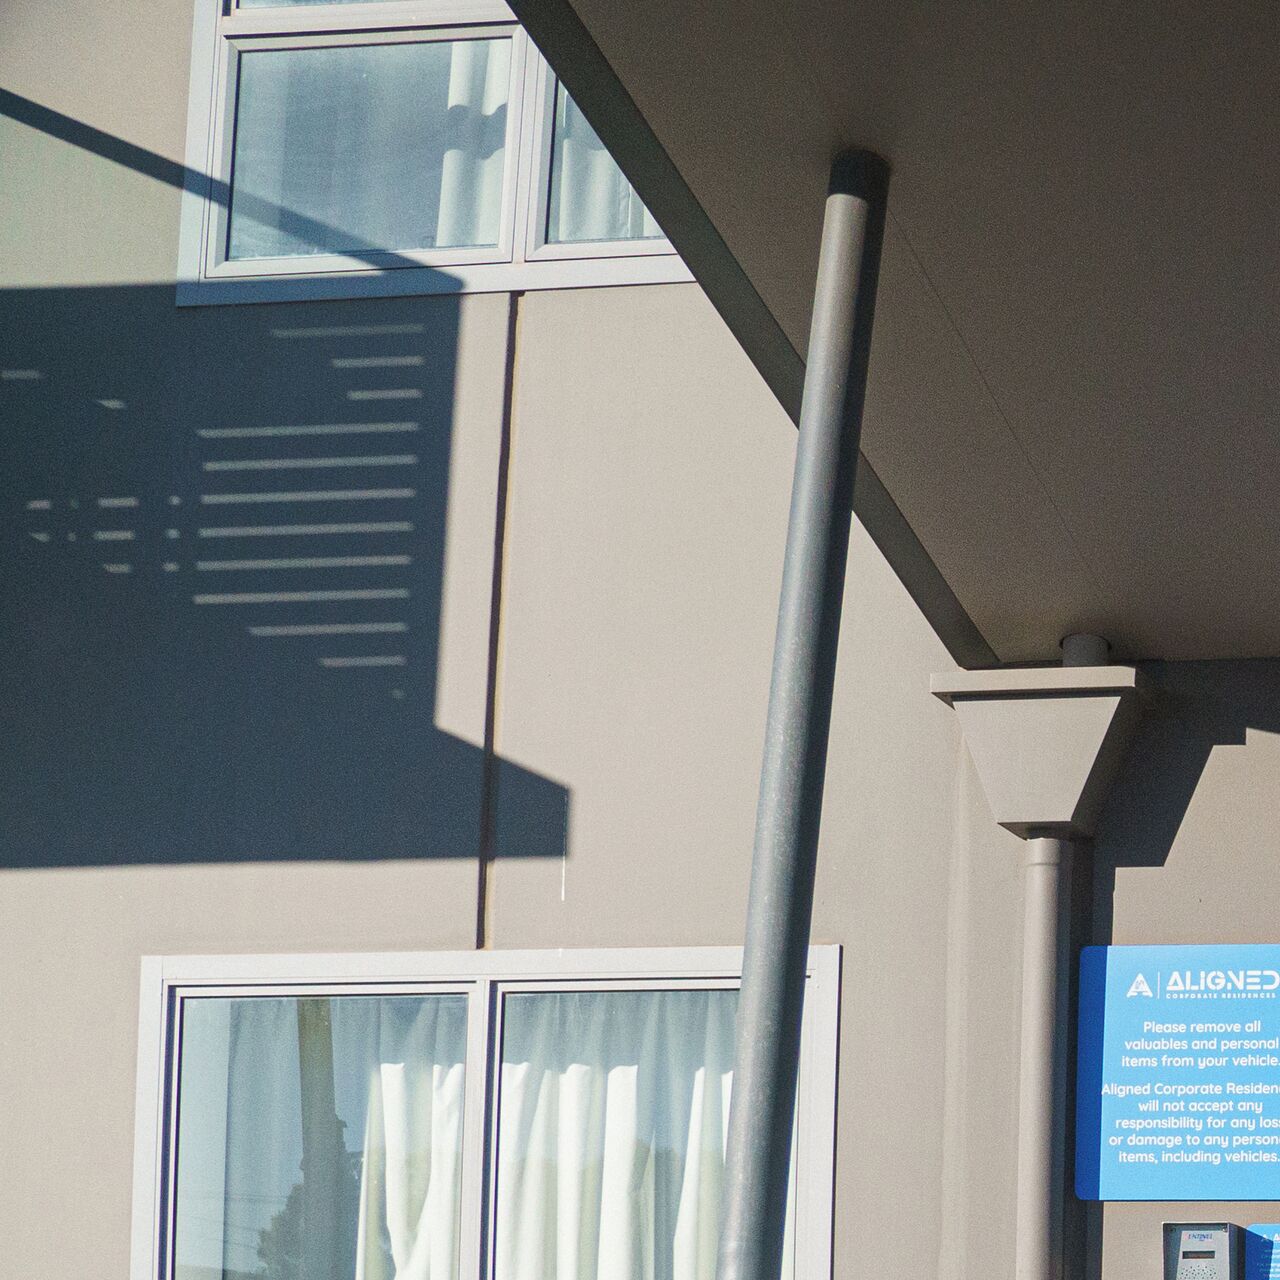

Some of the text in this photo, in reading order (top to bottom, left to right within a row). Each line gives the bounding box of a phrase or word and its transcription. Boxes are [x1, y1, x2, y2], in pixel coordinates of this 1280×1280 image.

[1166, 970, 1280, 990] ALIGNED
[1144, 1021, 1261, 1032] Please remove all
[1125, 1037, 1279, 1052] valuables and personal
[1122, 1055, 1280, 1069] items from your vehicle.
[1102, 1083, 1150, 1096] Aligned
[1155, 1083, 1222, 1096] Corporate
[1139, 1100, 1262, 1114] will not accept any
[1115, 1116, 1203, 1130] responsibility
[1207, 1117, 1226, 1128] for
[1231, 1119, 1255, 1131] any
[1109, 1136, 1123, 1145] or
[1127, 1134, 1182, 1147] damage
[1186, 1135, 1199, 1145] to
[1204, 1136, 1228, 1147] any
[1119, 1151, 1280, 1164] items, including vehicles.
